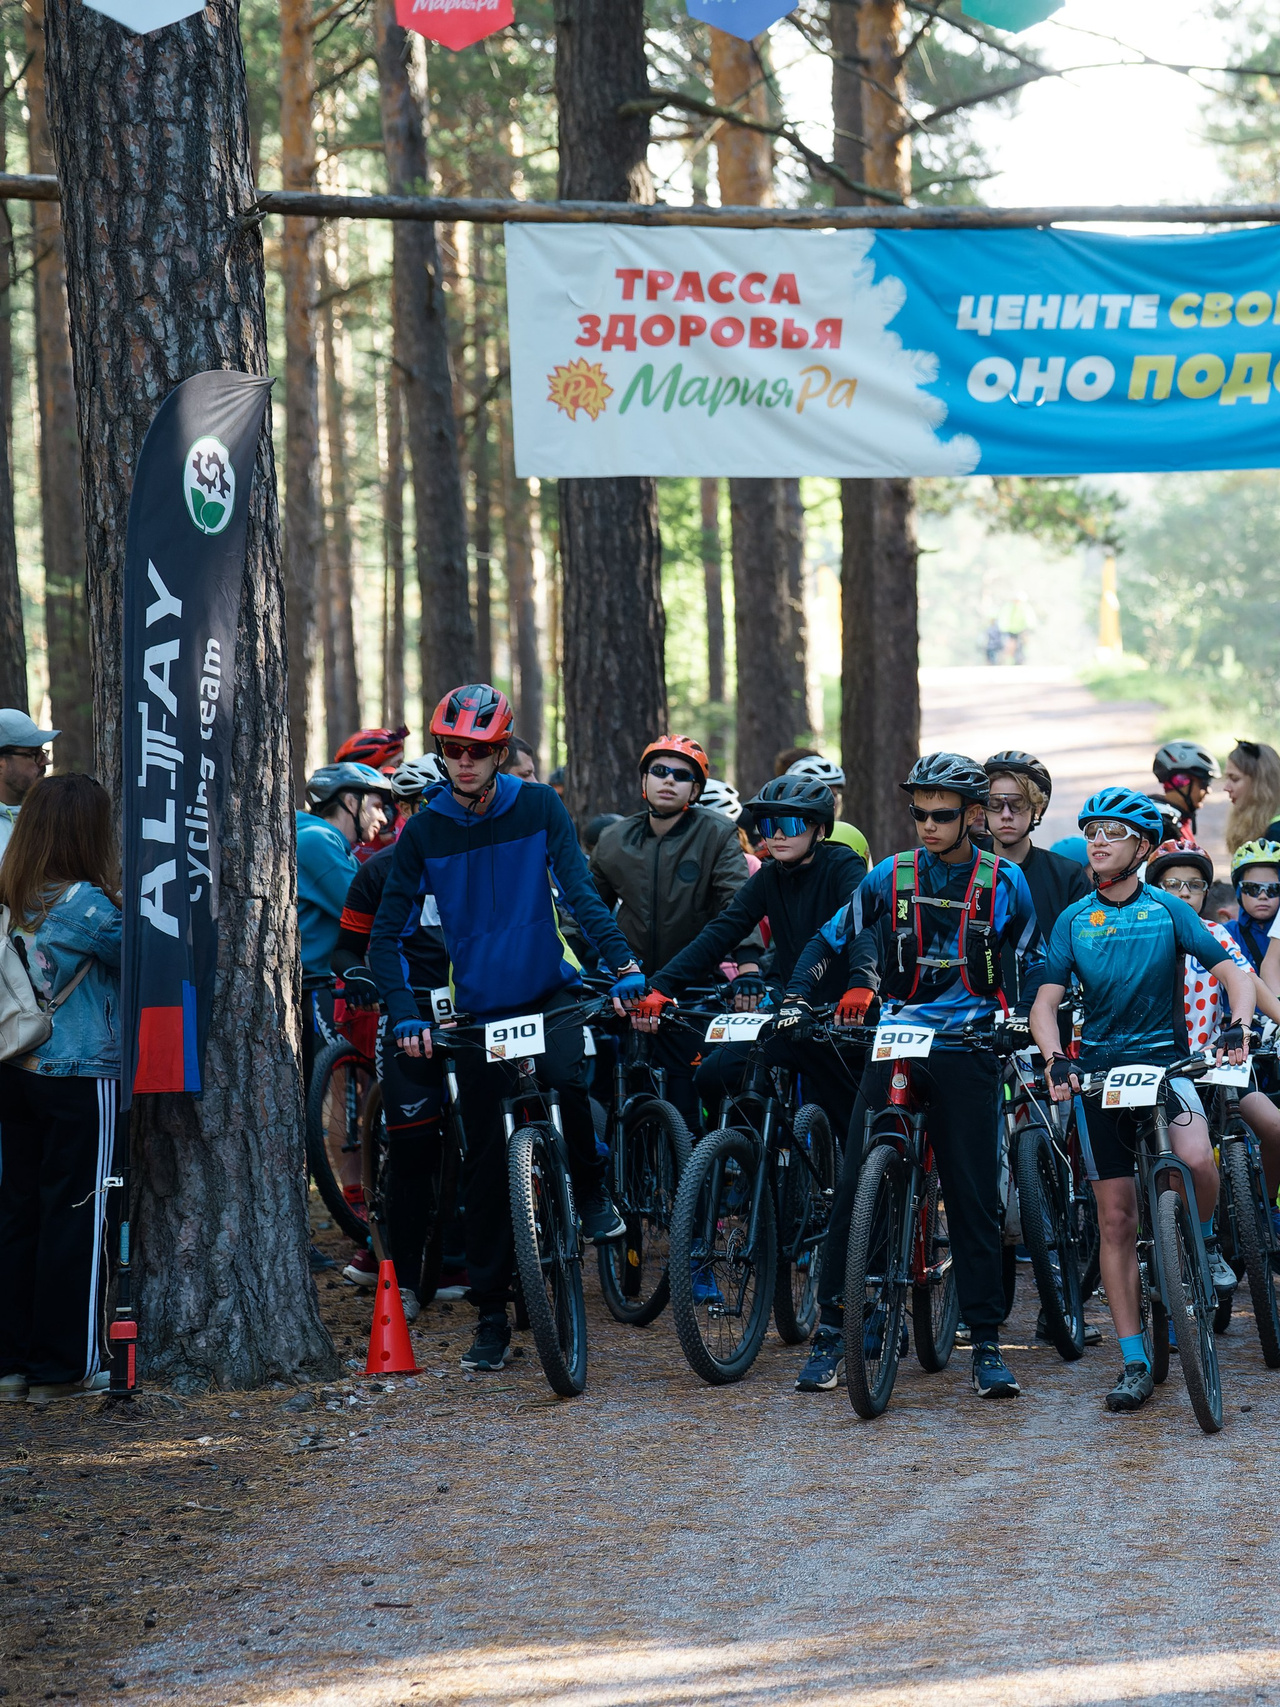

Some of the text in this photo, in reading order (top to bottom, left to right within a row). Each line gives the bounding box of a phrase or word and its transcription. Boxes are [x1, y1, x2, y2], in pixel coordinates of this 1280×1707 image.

[615, 268, 801, 306] ТРАССА
[956, 293, 1161, 337] ЦЕНИТЕ
[575, 313, 843, 352] ЗДОРОВЬЯ
[966, 355, 1116, 404] ОНО
[492, 1022, 536, 1043] 910
[777, 1016, 800, 1030] FOX
[1005, 1023, 1031, 1034] FOX
[880, 1031, 930, 1045] 907
[1109, 1072, 1158, 1088] 902
